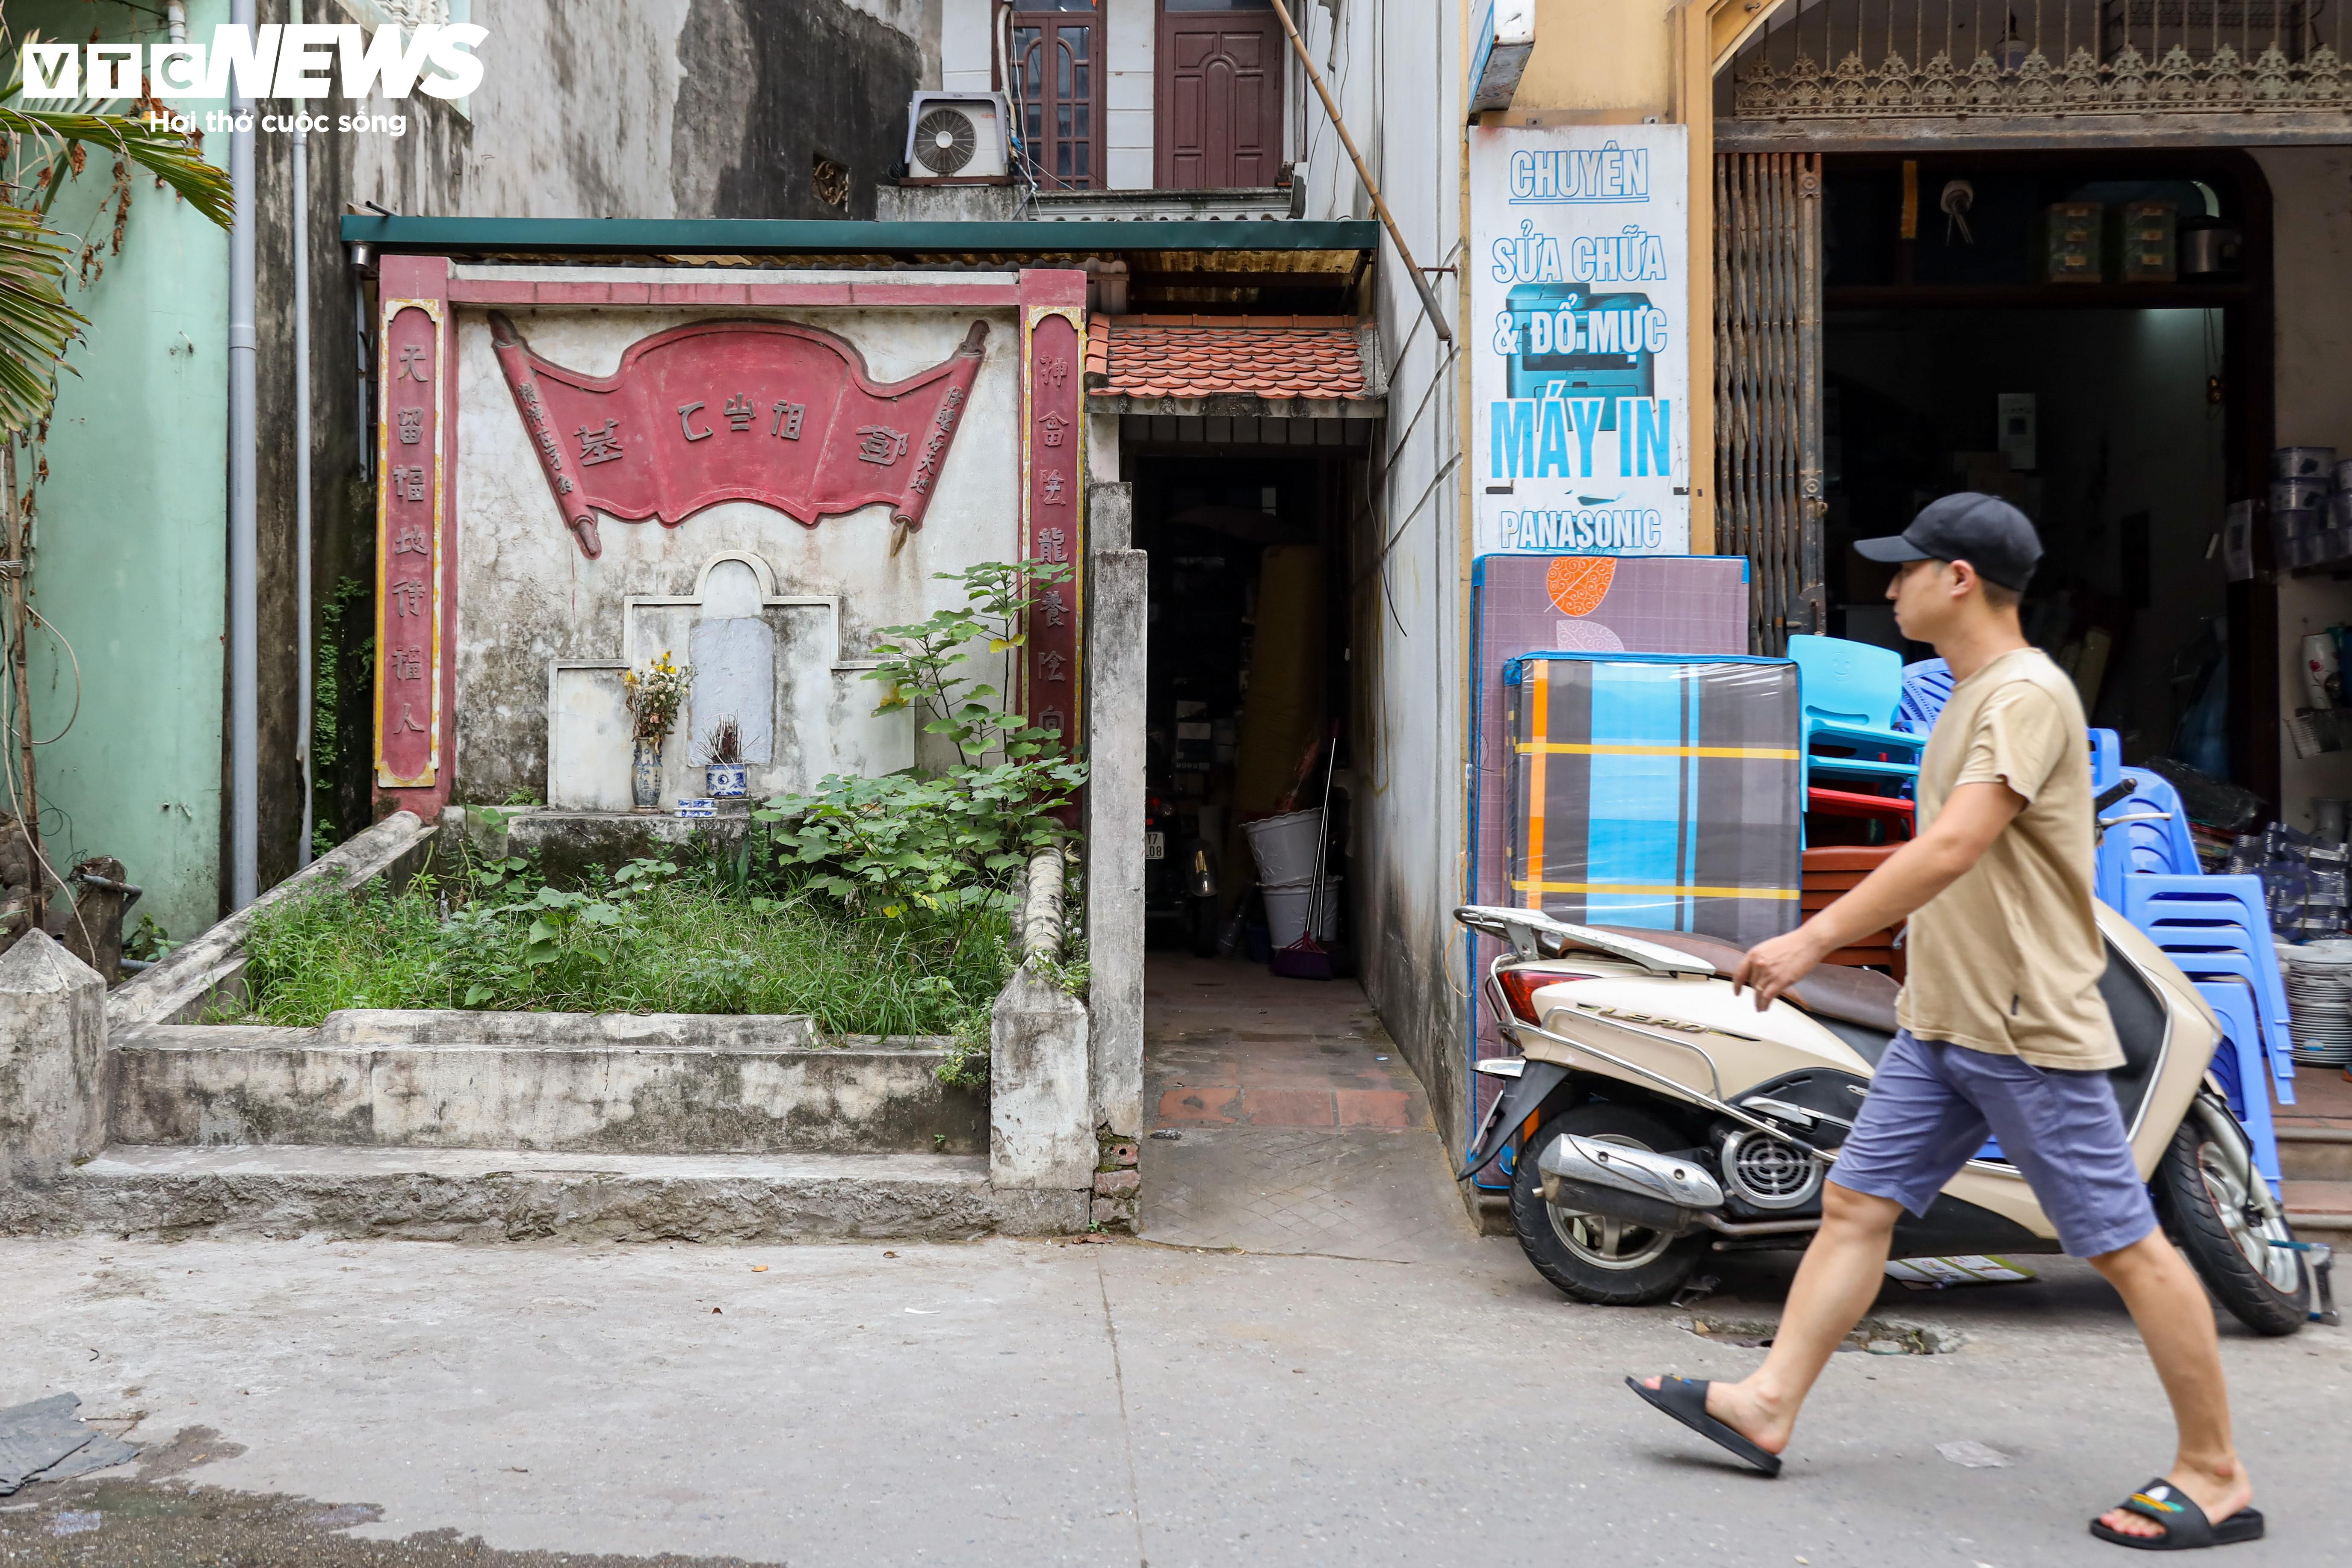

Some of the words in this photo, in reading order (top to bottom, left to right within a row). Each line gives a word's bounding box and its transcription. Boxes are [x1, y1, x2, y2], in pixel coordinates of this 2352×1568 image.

[1510, 140, 1648, 198] CHUYÊN
[1492, 219, 1563, 283] SỬA
[1571, 224, 1666, 282] CHỮA
[1493, 310, 1521, 355] &
[1529, 292, 1577, 355] ĐỔ
[1587, 304, 1667, 363] MỰC
[1490, 380, 1604, 478] MÁY
[1618, 398, 1670, 477] IN
[1501, 509, 1661, 549] PANASONIC
[1599, 1008, 1707, 1033] LEAD
